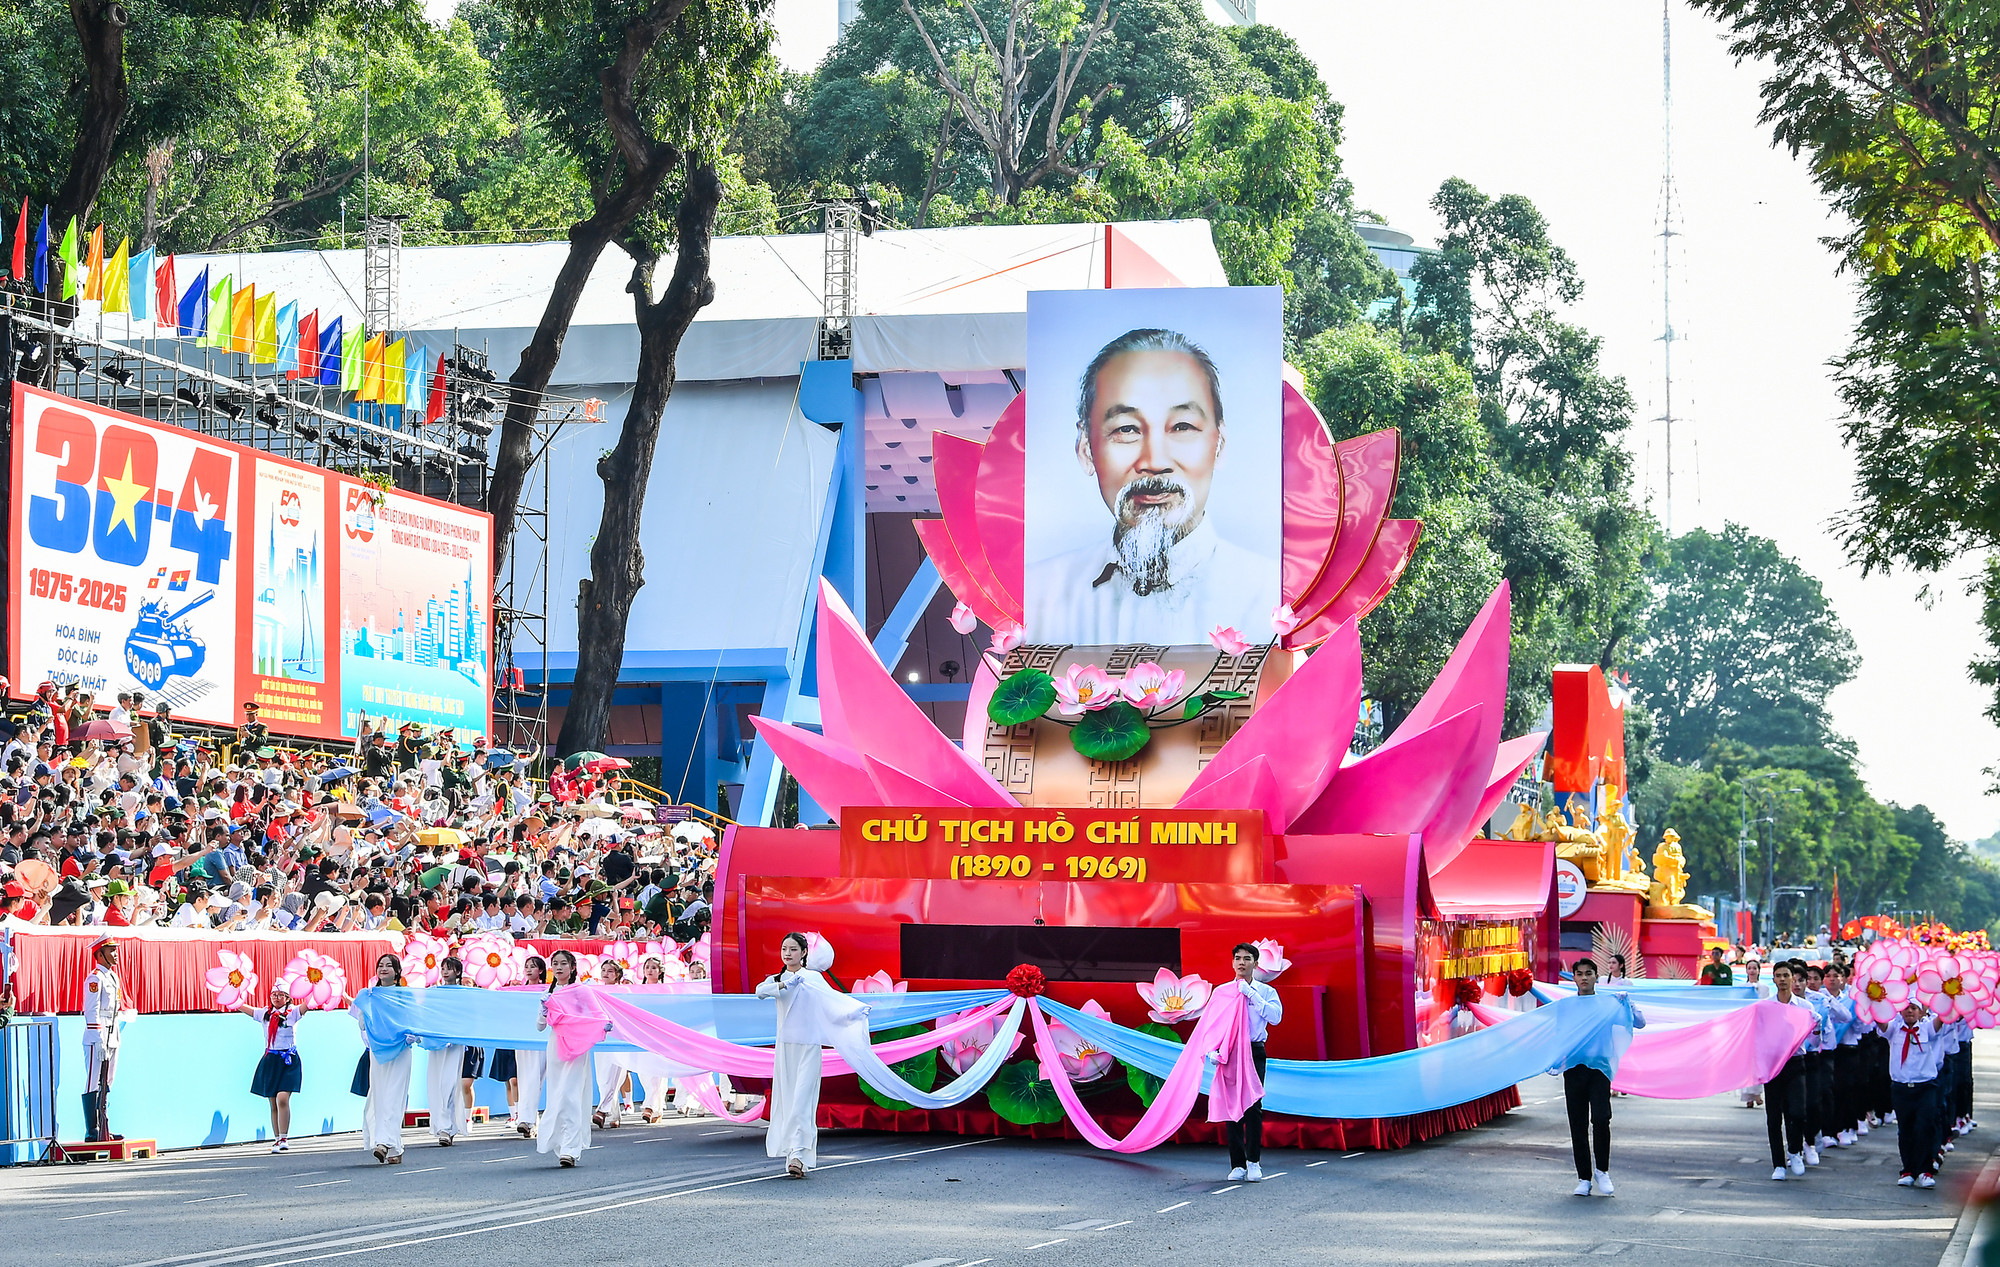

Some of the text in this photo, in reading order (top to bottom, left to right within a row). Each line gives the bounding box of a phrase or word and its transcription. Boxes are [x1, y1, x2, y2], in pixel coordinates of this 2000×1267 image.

[29, 406, 232, 585] 30-4
[56, 622, 101, 644] HÒA BÌNH
[58, 646, 98, 669] ĐỘC LẬP
[81, 674, 106, 691] NHẤT
[862, 812, 1237, 847] CHỦ TỊCH HỒ CHÍ MINH
[950, 855, 1031, 880] (1890
[1066, 856, 1147, 883] 1969)
